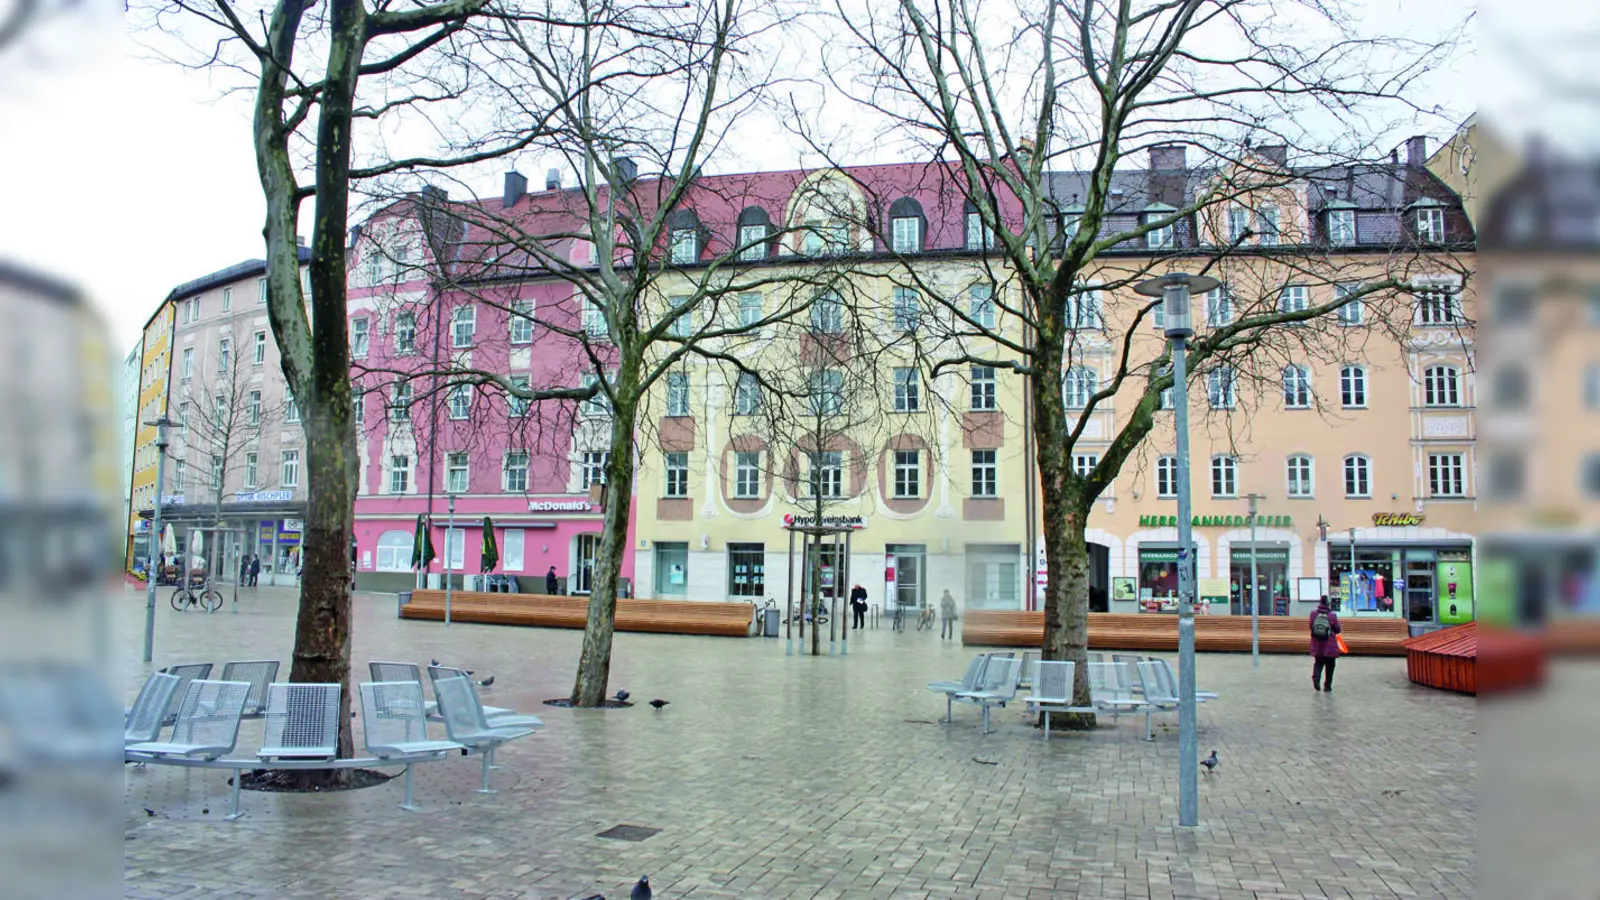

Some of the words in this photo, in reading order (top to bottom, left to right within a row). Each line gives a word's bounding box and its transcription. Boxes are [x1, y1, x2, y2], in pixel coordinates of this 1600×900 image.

[528, 501, 592, 511] McDonald's
[794, 515, 863, 525] Hyporeinsbank
[1139, 514, 1292, 526] HERRANNSDORFER
[1372, 512, 1425, 526] Tchibo
